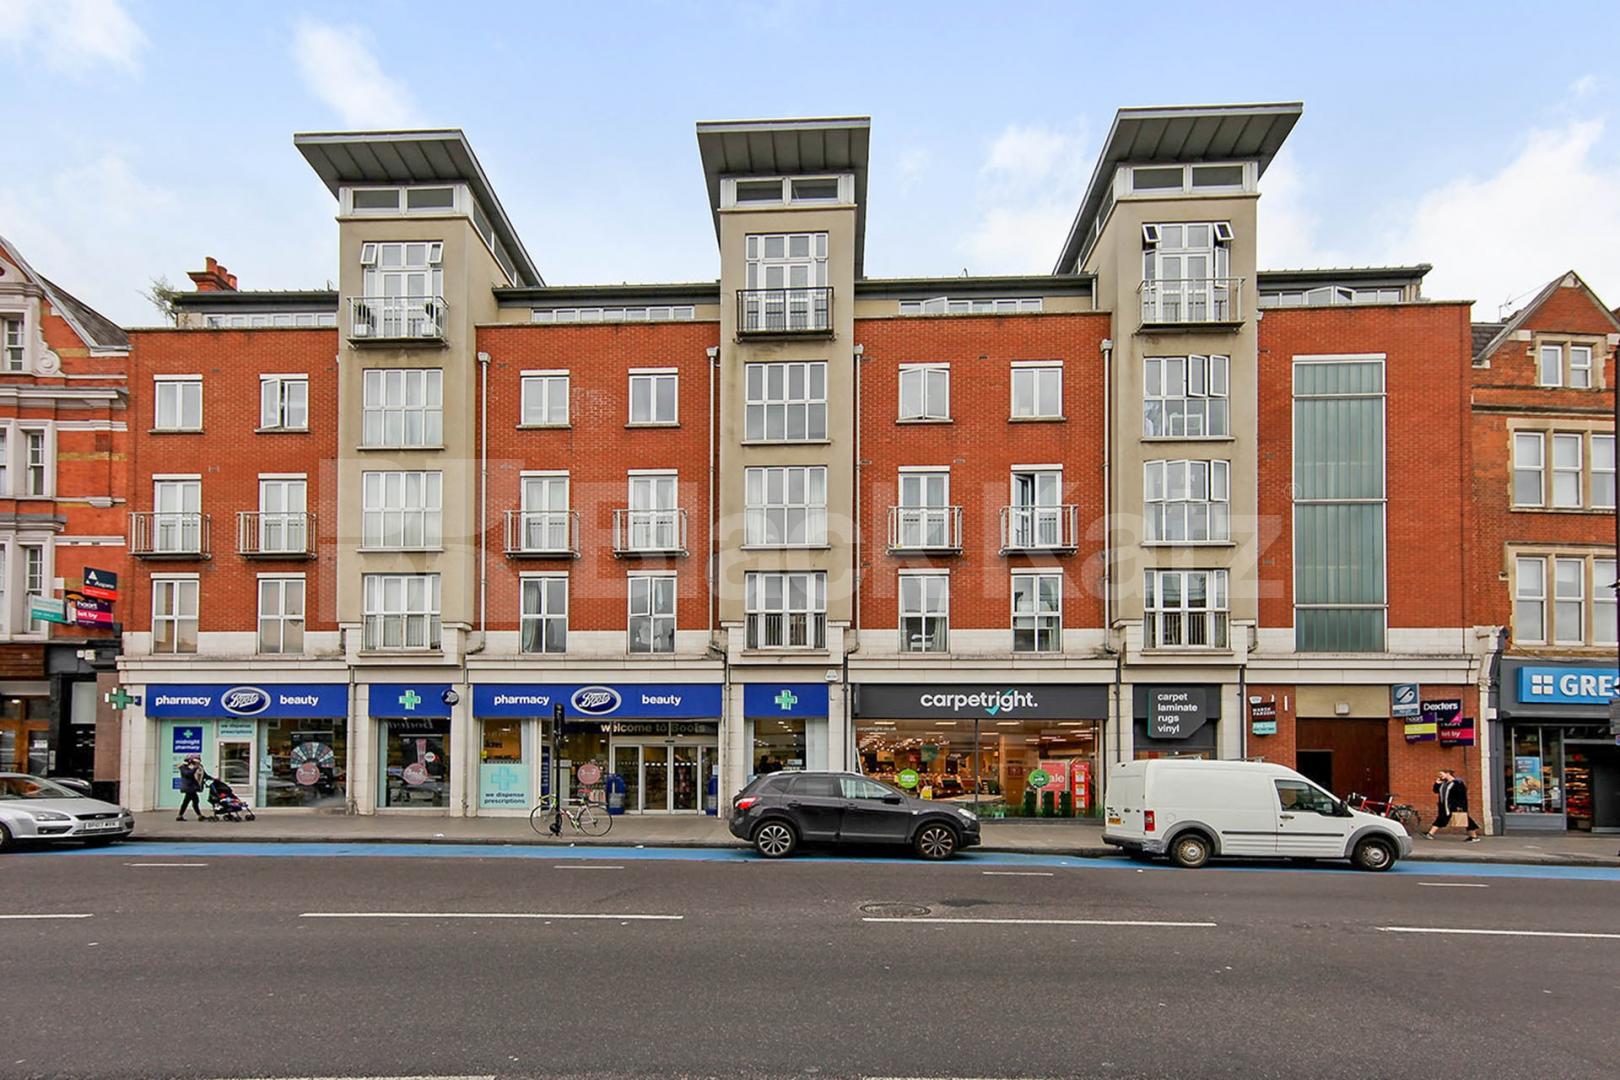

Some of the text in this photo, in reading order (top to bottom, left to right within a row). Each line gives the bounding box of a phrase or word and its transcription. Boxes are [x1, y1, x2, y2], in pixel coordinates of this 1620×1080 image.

[155, 695, 212, 707] pharmacy
[227, 692, 260, 708] Boots
[279, 695, 319, 707] beauty
[494, 695, 550, 706] pharmacy
[579, 692, 611, 708] Boots
[641, 694, 682, 706] beauty
[1157, 693, 1188, 703] carpet
[1157, 703, 1198, 712] laminate
[1423, 702, 1459, 711] Dexters
[1157, 714, 1180, 723] rugs
[601, 721, 652, 733] welcome
[656, 722, 667, 733] to
[1157, 724, 1180, 735] vinyl
